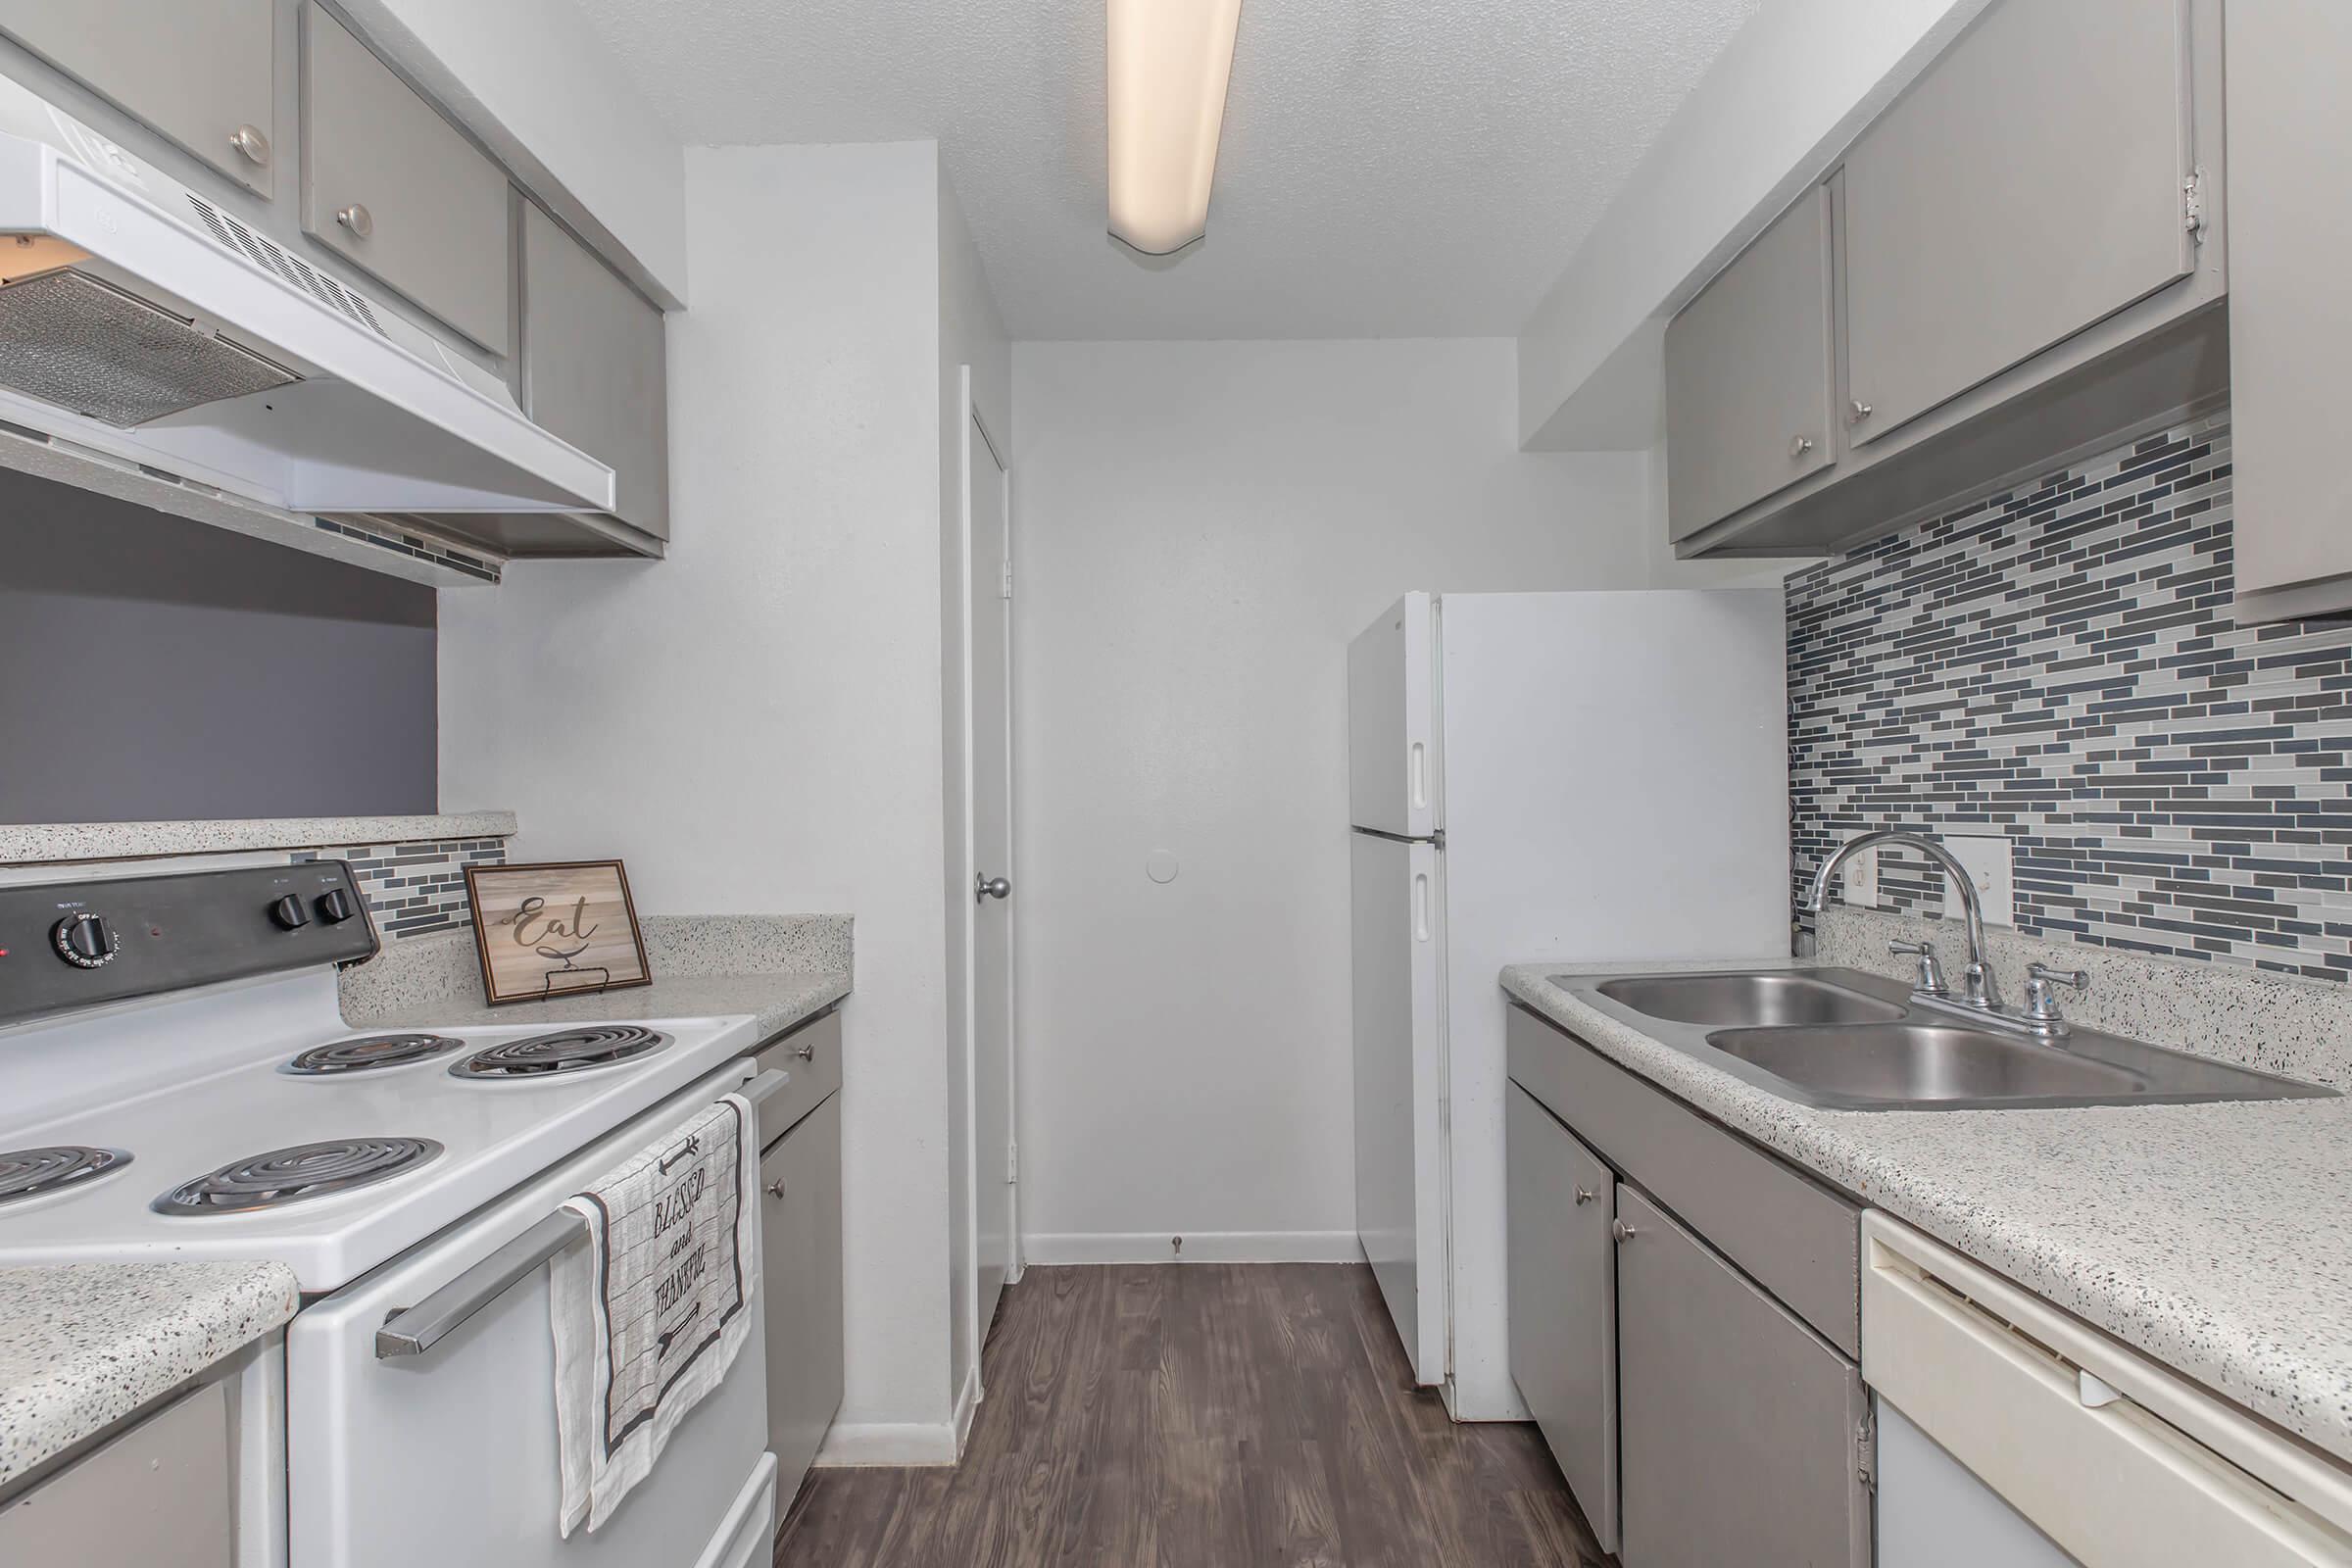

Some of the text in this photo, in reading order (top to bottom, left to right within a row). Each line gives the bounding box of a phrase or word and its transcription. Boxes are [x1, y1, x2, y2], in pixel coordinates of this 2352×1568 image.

[512, 896, 599, 947] Eat
[654, 1167, 705, 1239] BLESSED
[669, 1221, 693, 1258] and
[655, 1242, 707, 1318] THANKFUL
